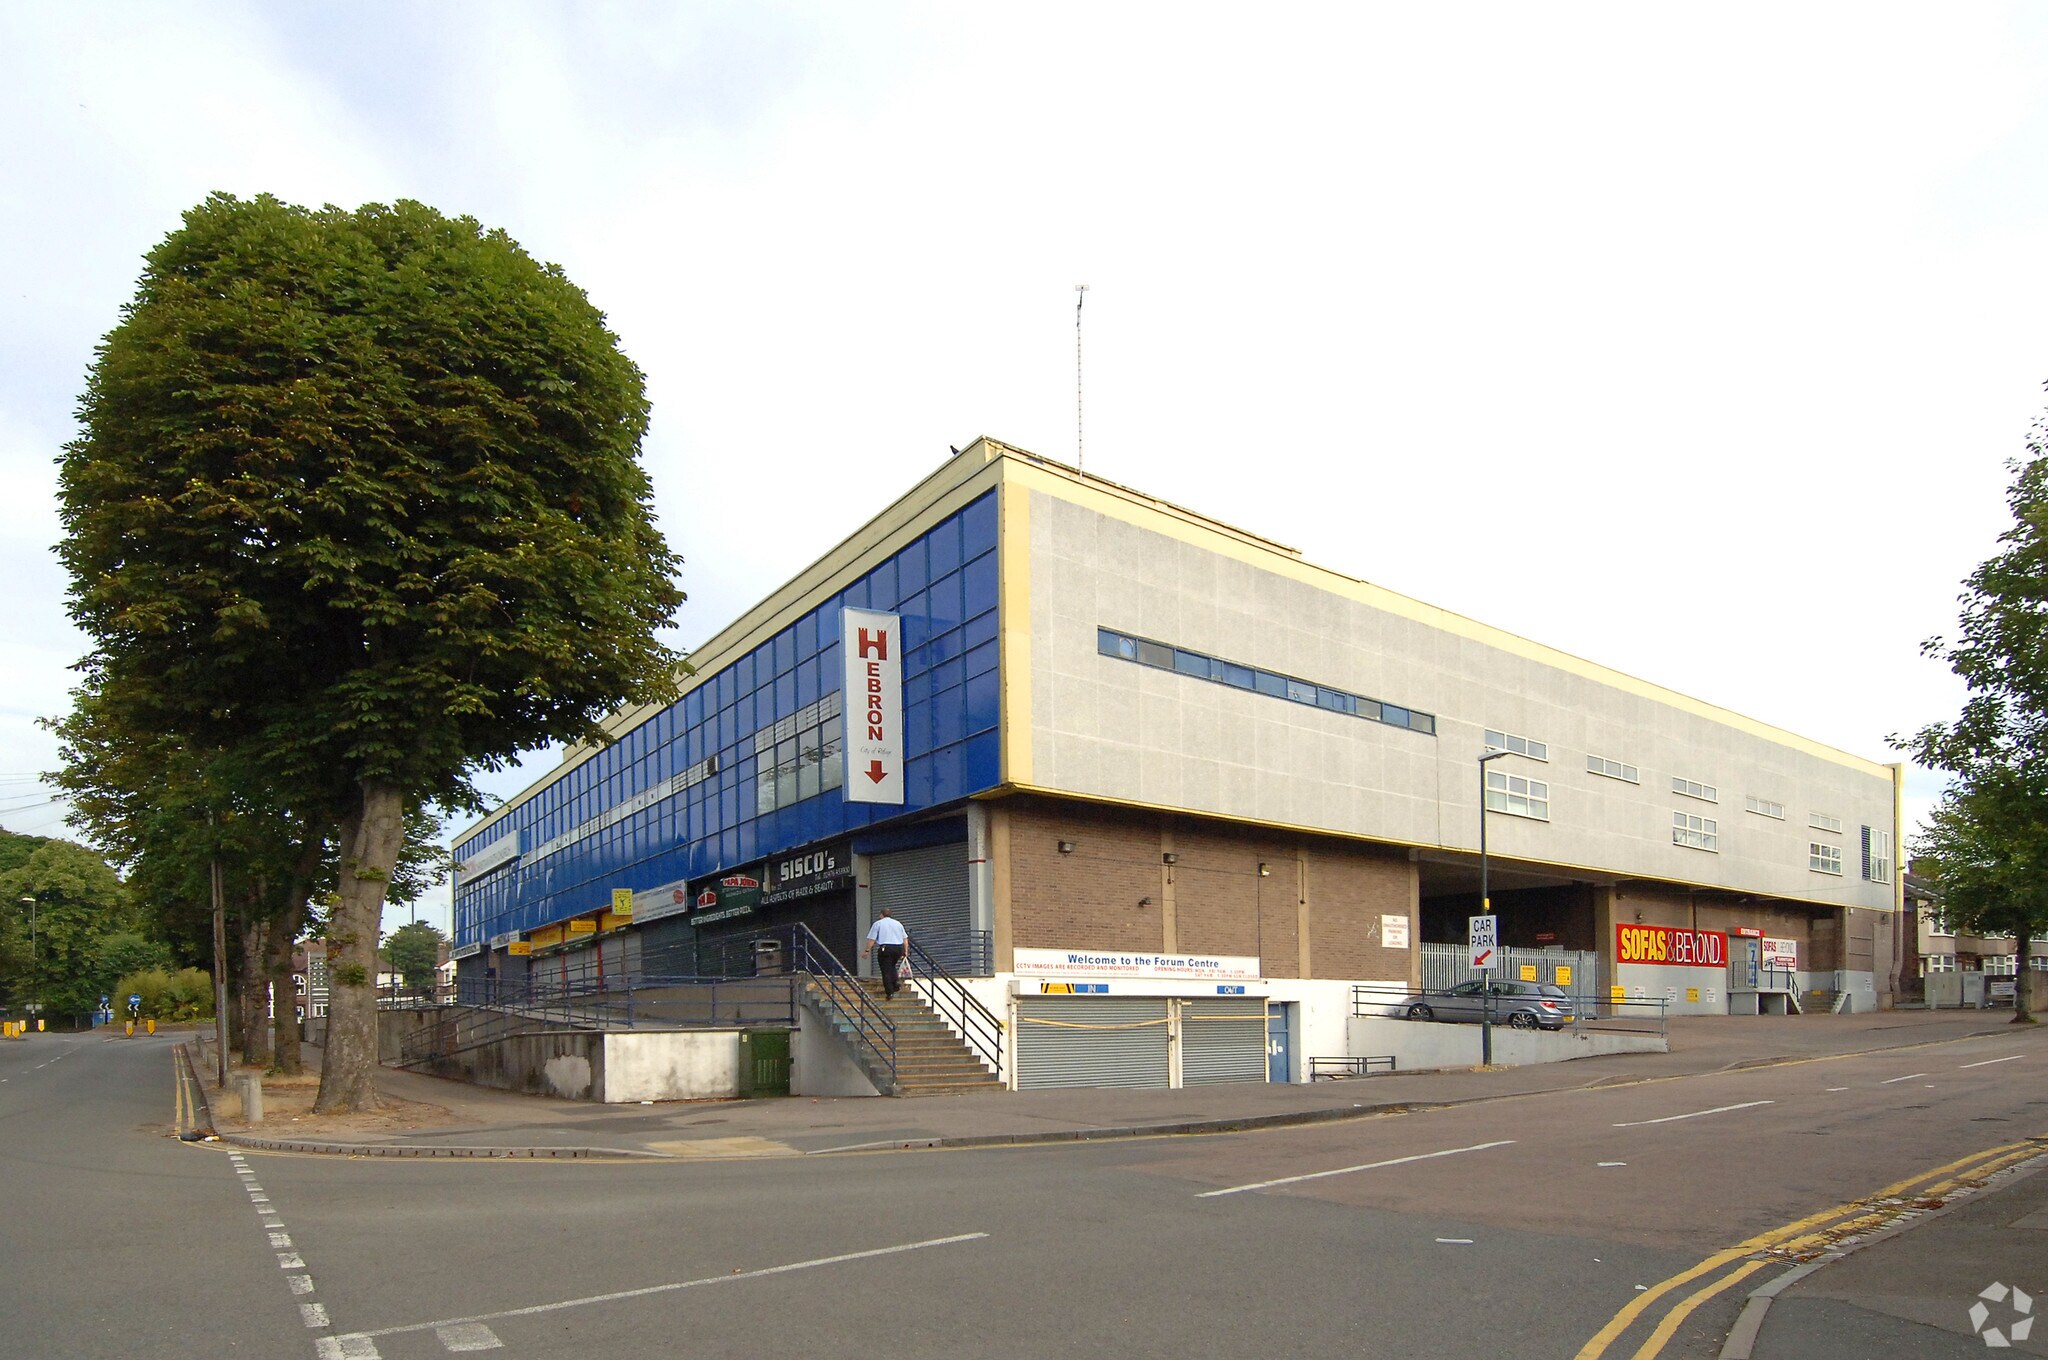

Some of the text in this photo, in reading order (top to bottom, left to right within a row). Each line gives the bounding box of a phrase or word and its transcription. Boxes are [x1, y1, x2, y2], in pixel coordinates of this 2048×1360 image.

[858, 627, 887, 741] HEBRON
[781, 850, 835, 881] SISCO's
[725, 878, 738, 886] PAPA
[761, 895, 769, 905] ALL
[770, 890, 788, 903] ASPECTS
[788, 889, 795, 900] OF
[795, 886, 809, 898] HAIR
[814, 880, 834, 893] BEAUTY
[1473, 919, 1491, 932] CAR
[1472, 934, 1494, 947] PARK
[1621, 928, 1720, 964] SOFAS & BEYOND
[1763, 941, 1777, 952] SOFAS
[1068, 954, 1219, 968] Welcome to the Forum Centre
[1088, 984, 1096, 993] IN
[1224, 986, 1238, 994] OUT
